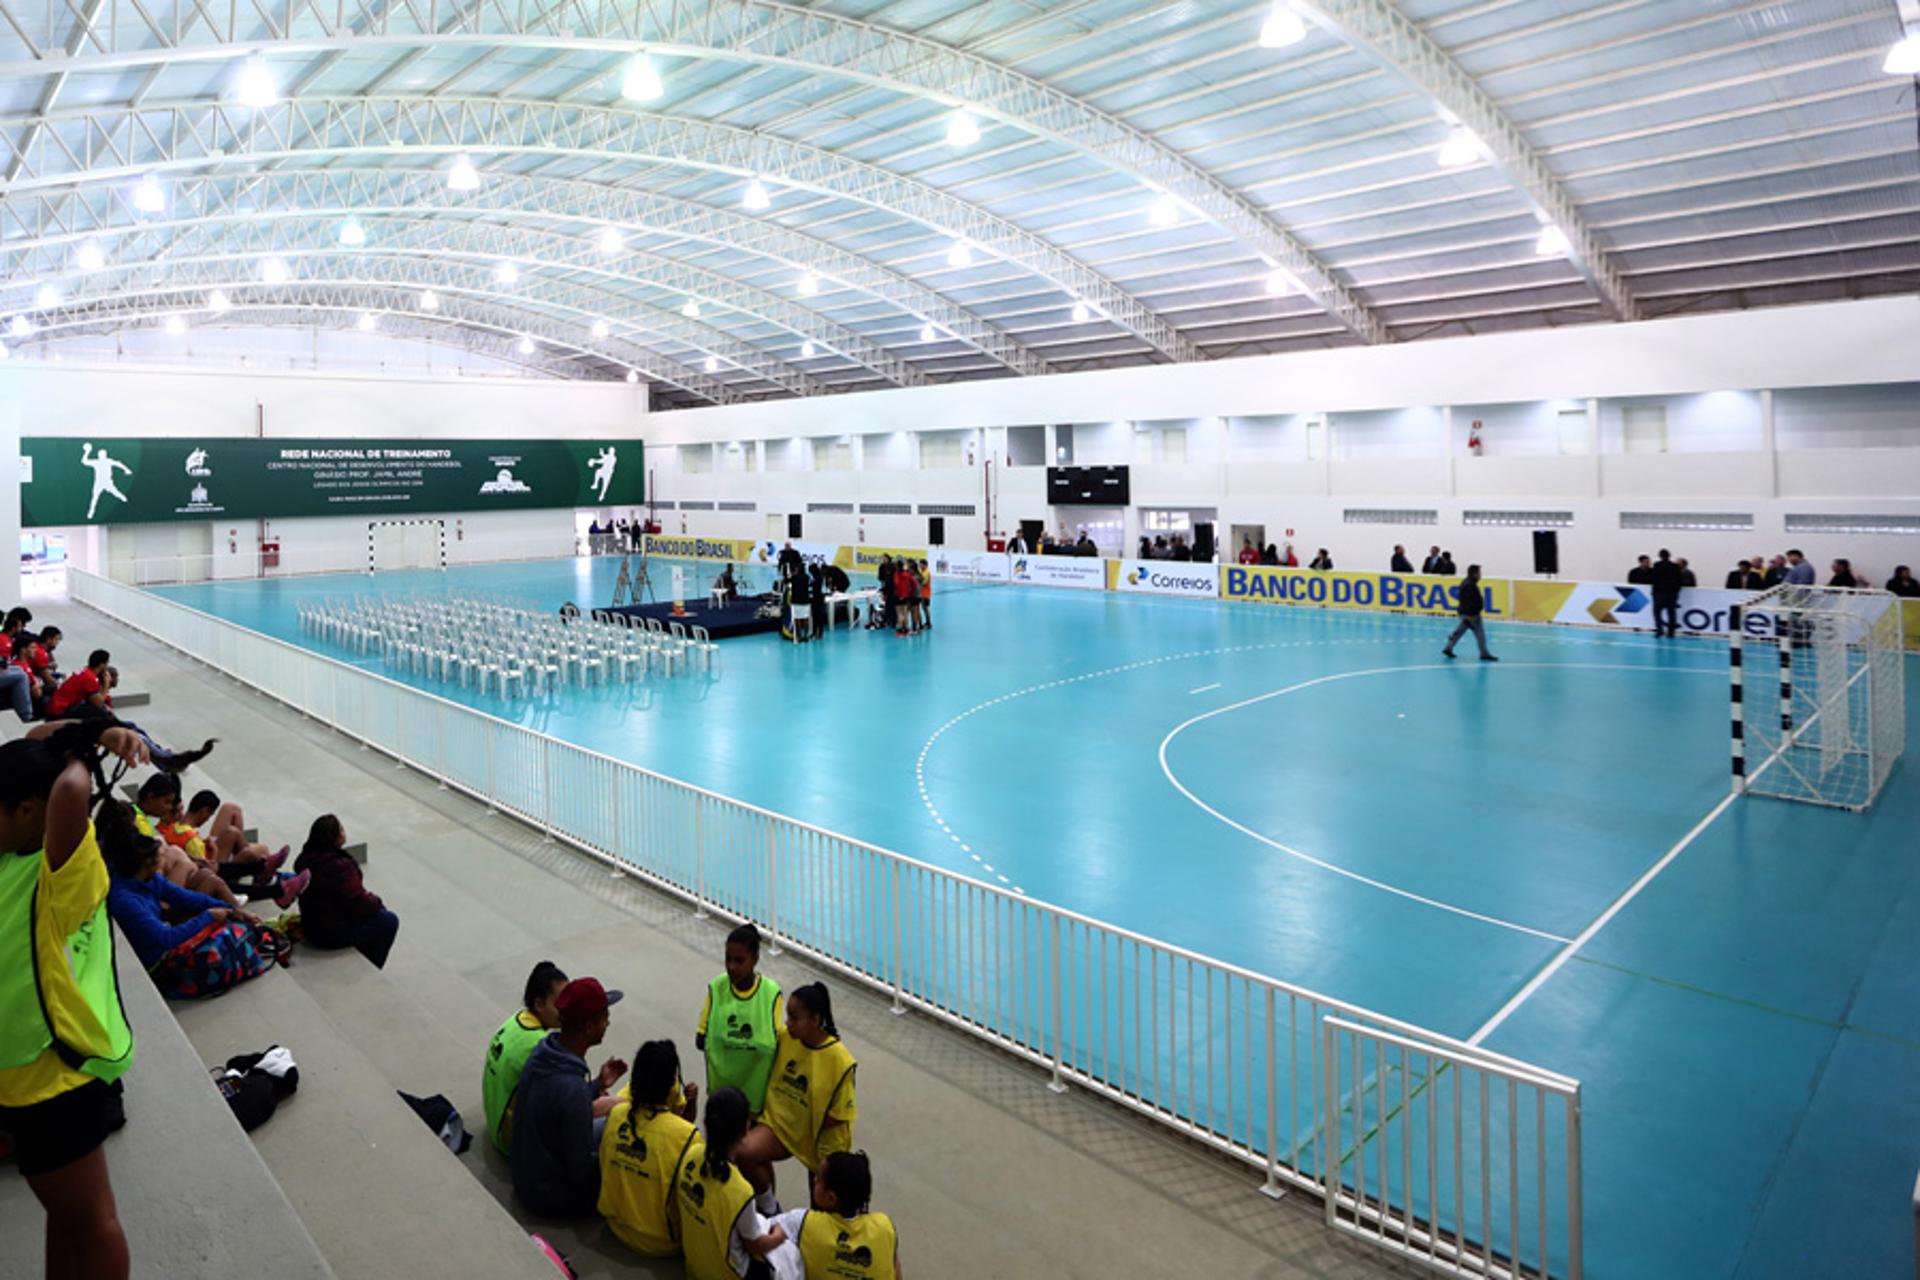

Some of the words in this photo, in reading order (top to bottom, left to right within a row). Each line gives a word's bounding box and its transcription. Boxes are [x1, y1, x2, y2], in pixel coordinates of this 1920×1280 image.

[281, 449, 309, 459] REDE
[311, 449, 365, 459] NACIONAL
[366, 449, 381, 459] DE
[383, 449, 451, 459] TREINAMENTO
[646, 537, 679, 555] BANCO
[681, 540, 694, 556] DO
[695, 539, 734, 559] BRASIL
[1151, 573, 1213, 592] Correios
[1227, 567, 1327, 602] BANCO
[1332, 577, 1374, 605] DO
[1379, 575, 1502, 614] BRASL
